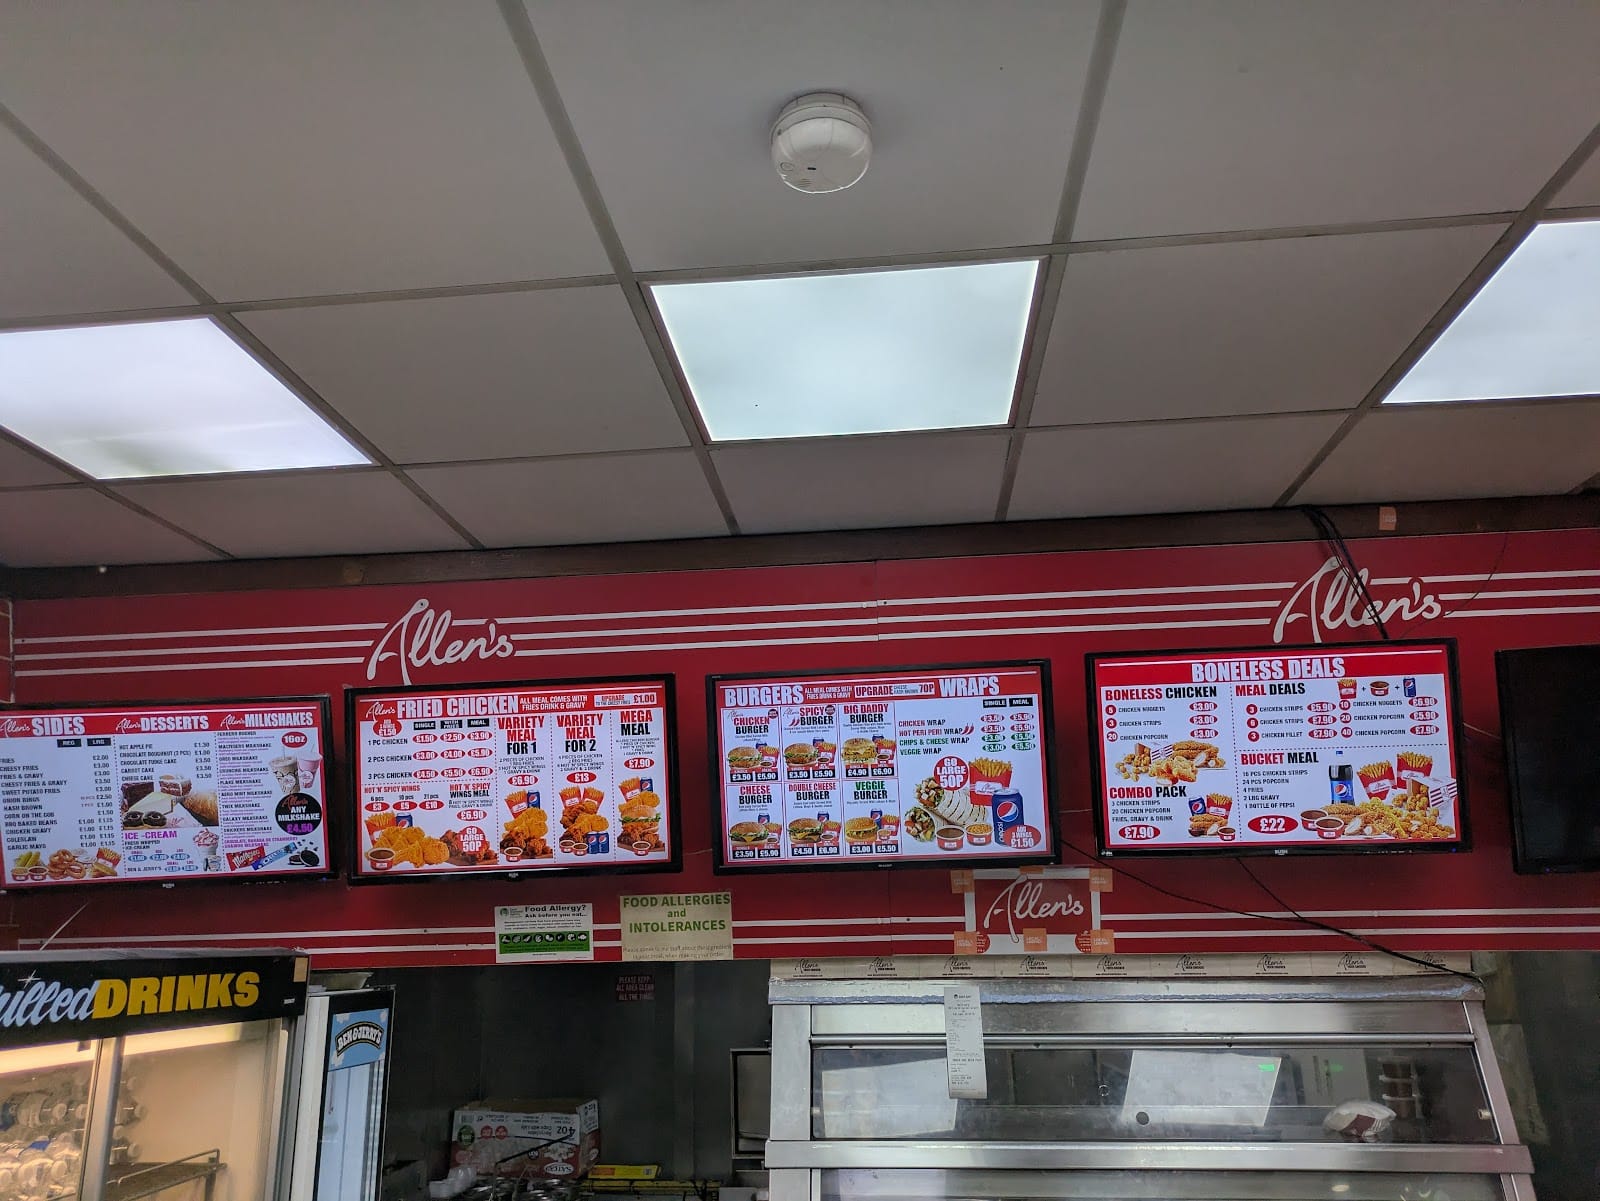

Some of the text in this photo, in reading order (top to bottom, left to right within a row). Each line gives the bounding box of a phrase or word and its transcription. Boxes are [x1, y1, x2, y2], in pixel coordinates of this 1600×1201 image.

[1273, 557, 1441, 644] Allen's
[367, 599, 514, 685] Allen's
[1191, 657, 1345, 682] BONELESS DEALS
[856, 685, 893, 696] UPGRADE
[920, 684, 933, 692] 70P
[939, 676, 1000, 696] WRAPS
[1235, 683, 1305, 696] MEAL DEALS
[725, 685, 803, 707] BURGERS
[1105, 686, 1217, 701] BONELESS CHICKEN
[634, 695, 655, 703] £1.00
[1413, 697, 1435, 706] £6.90
[366, 696, 518, 721] Allen's FRIED CHICKEN
[800, 707, 824, 716] SPICY
[844, 704, 888, 714] BIG DADDY
[1193, 702, 1214, 711] £3.00
[1311, 703, 1332, 712] £5.90
[220, 712, 313, 729] Allen's MILKSHAKES
[557, 713, 603, 727] VARIETY
[621, 711, 653, 723] MEGA
[850, 714, 883, 723] BURGER
[1193, 716, 1215, 724] £3.00
[1312, 716, 1333, 724] £7.90
[1414, 711, 1436, 720] £5.90
[32, 716, 85, 736] SIDES
[116, 716, 209, 733] Allen's DESSERTS
[498, 716, 544, 729] VARIETY
[734, 717, 770, 726] CHICKEN
[800, 716, 833, 726] BURGER
[566, 727, 595, 740] MEAL
[621, 723, 650, 735] MEAL
[736, 725, 768, 734] BURGER
[1194, 729, 1215, 738] £3.00
[1313, 729, 1334, 738] £7.90
[1415, 726, 1436, 735] £7.90
[416, 731, 489, 742] £1.50 £2.50 £3.90
[507, 729, 536, 742] MEAL
[926, 737, 949, 745] CHEESE
[951, 736, 969, 744] WRAP
[507, 742, 536, 755] FOR 1
[565, 739, 596, 752] FOR 2
[629, 759, 651, 768] £7.90
[944, 758, 957, 767] GO
[1241, 752, 1319, 765] BUCKET MEAL
[789, 770, 833, 779] £3.50 £5.90
[848, 767, 892, 777] £4.90 £6.90
[937, 766, 966, 775] LARGE
[512, 776, 535, 785] £6.90
[574, 773, 589, 782] £13
[732, 772, 776, 781] £3.50 £5.90
[940, 775, 963, 788] 50P
[740, 785, 770, 795] CHEESE
[789, 783, 836, 792] DOUBLE CHEESE
[856, 780, 885, 790] VEGGIE
[796, 791, 830, 801] BURGER
[854, 790, 888, 800] BURGER
[1110, 786, 1187, 799] COMBO PACK
[739, 794, 772, 804] BURGER
[278, 813, 320, 822] MILKSHAKE
[461, 810, 484, 820] £6.90
[1260, 818, 1285, 831] £22
[1124, 826, 1154, 838] £7.90
[463, 841, 481, 851] 50P
[1011, 838, 1034, 847] £1.50
[735, 849, 778, 858] £3.50 £5.90
[623, 894, 730, 908] FOOD ALLERGIES
[668, 909, 686, 918] and
[984, 874, 1084, 943] Allen's
[630, 920, 726, 933] INTOLERANCES
[92, 972, 260, 1019] DRINKS
[338, 1029, 352, 1050] BEN
[358, 1026, 382, 1044] JERRY'S
[569, 1127, 575, 1136] 4
